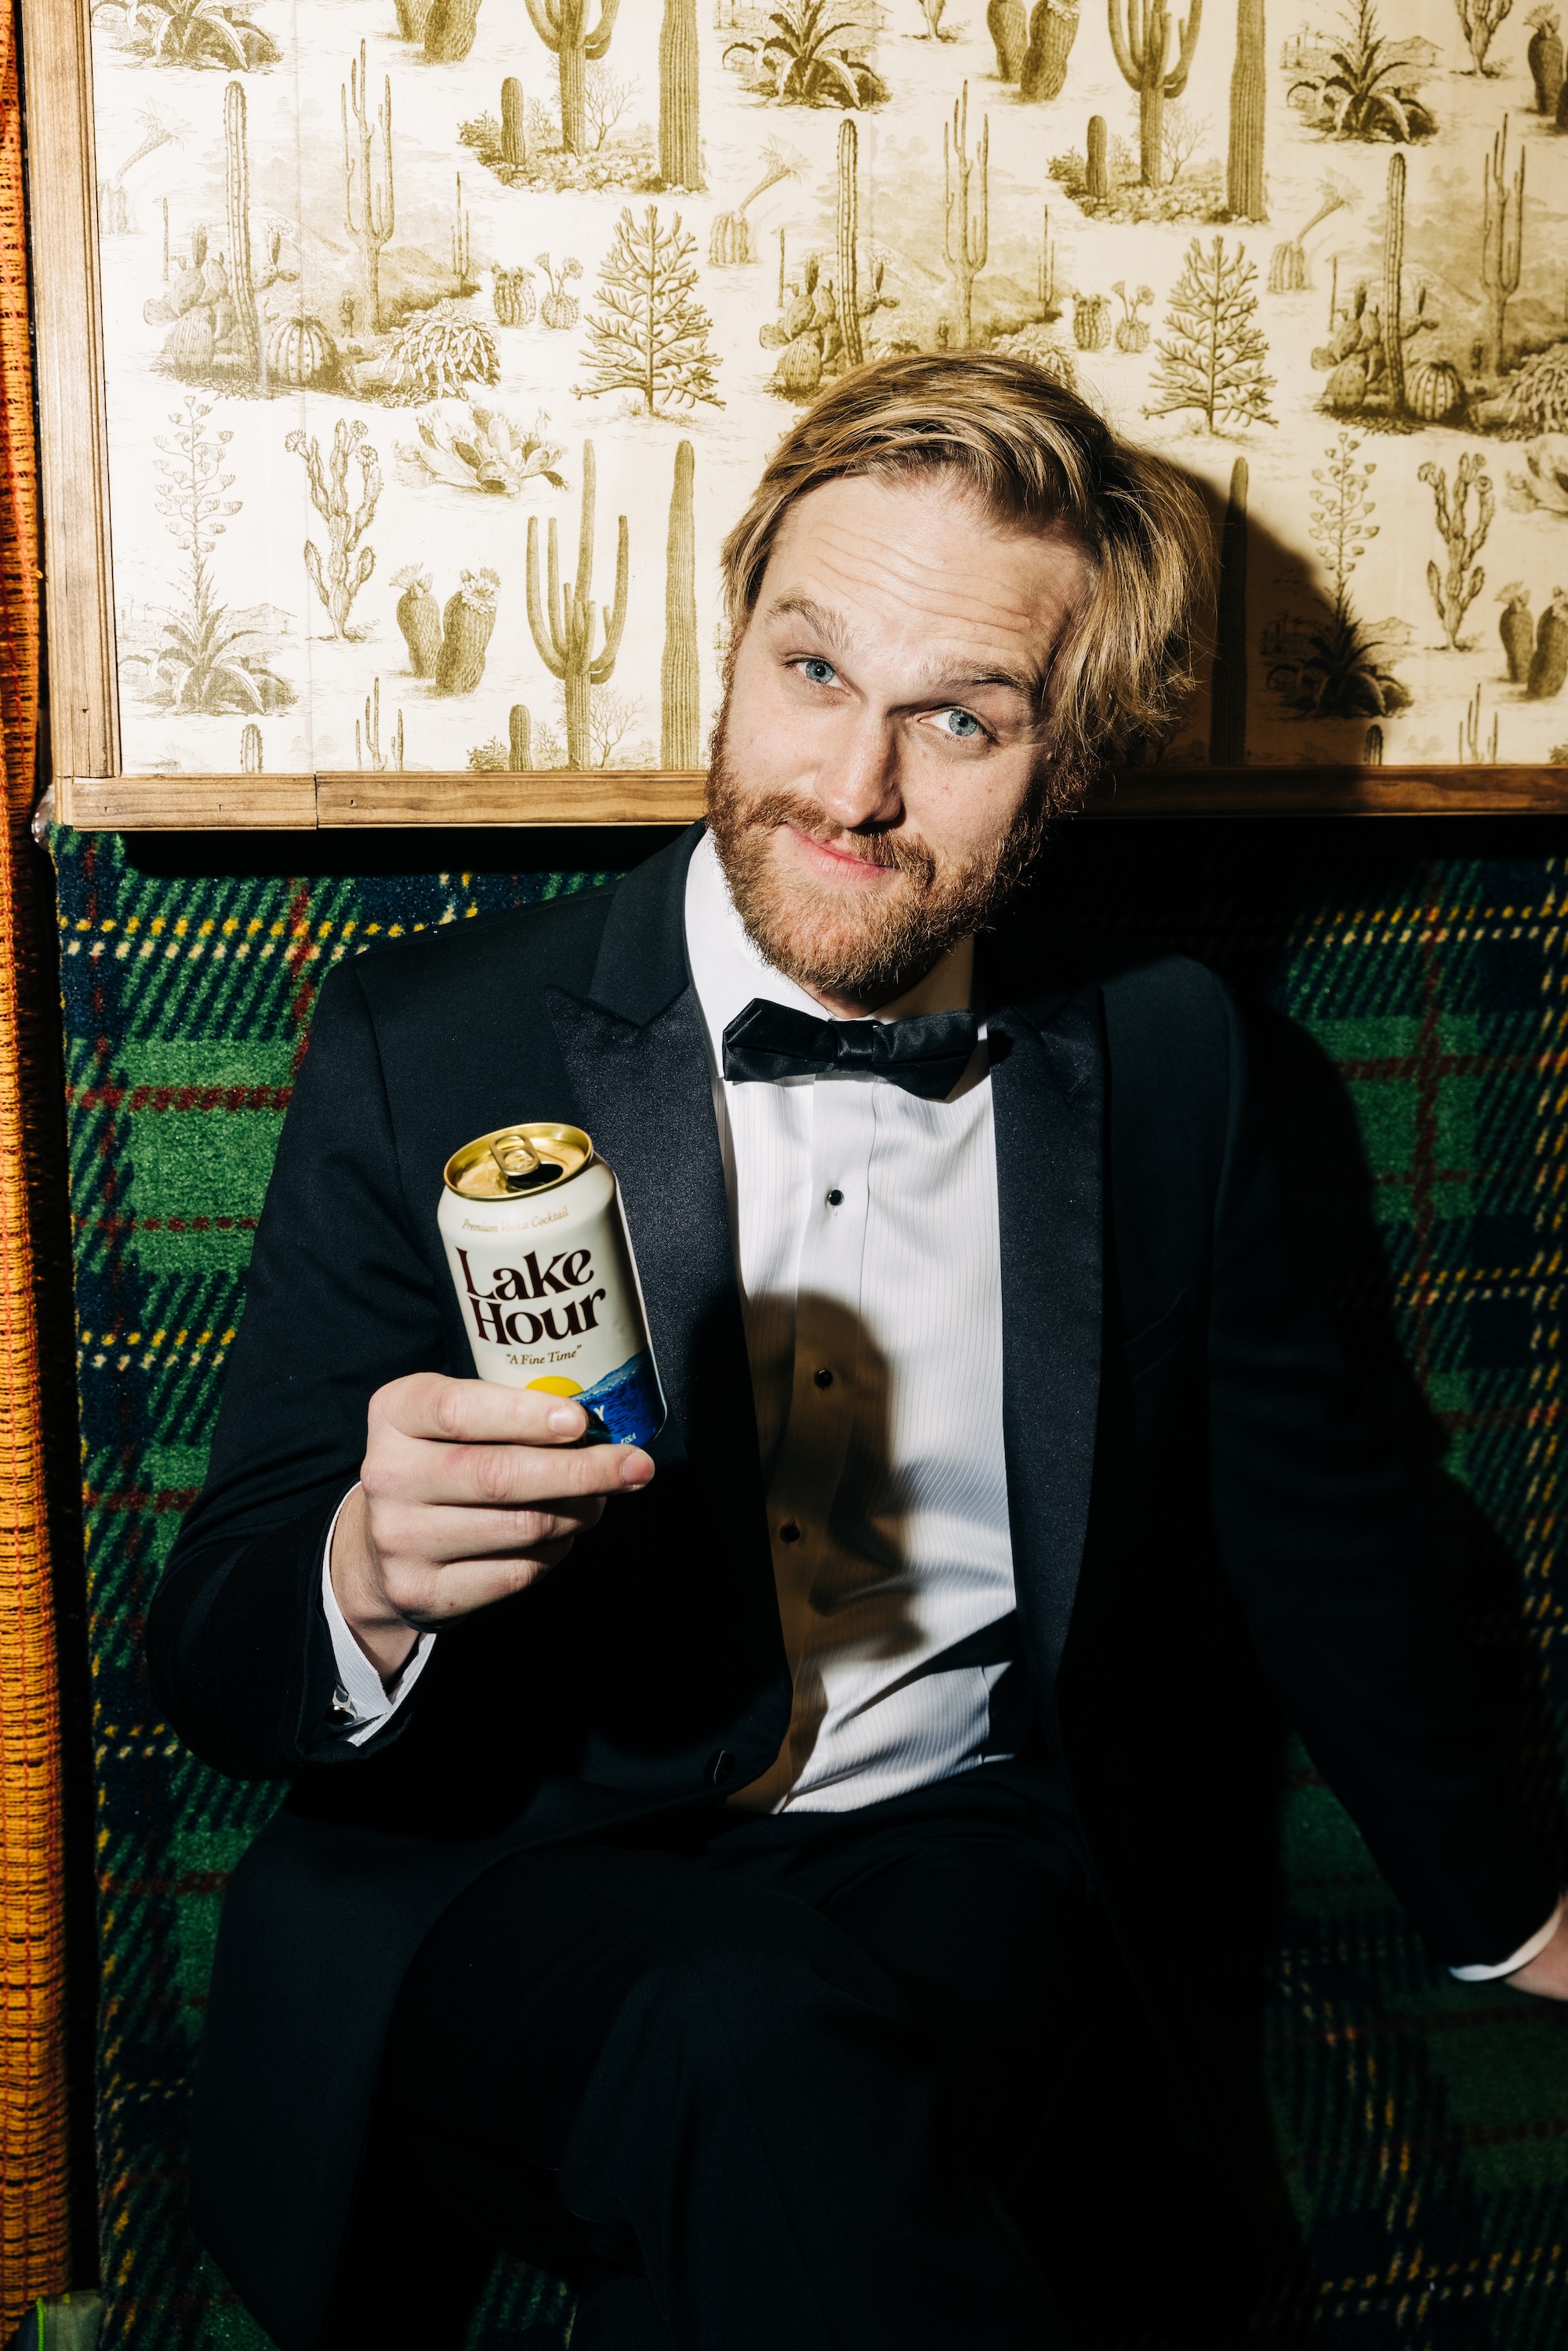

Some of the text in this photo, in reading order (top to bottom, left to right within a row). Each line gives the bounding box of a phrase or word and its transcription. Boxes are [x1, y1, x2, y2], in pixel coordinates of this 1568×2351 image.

[462, 1219, 498, 1233] Premium
[532, 1205, 569, 1228] Cocktail
[456, 1247, 594, 1301] Lake
[467, 1288, 606, 1346] Hour
[521, 1354, 546, 1365] Fine
